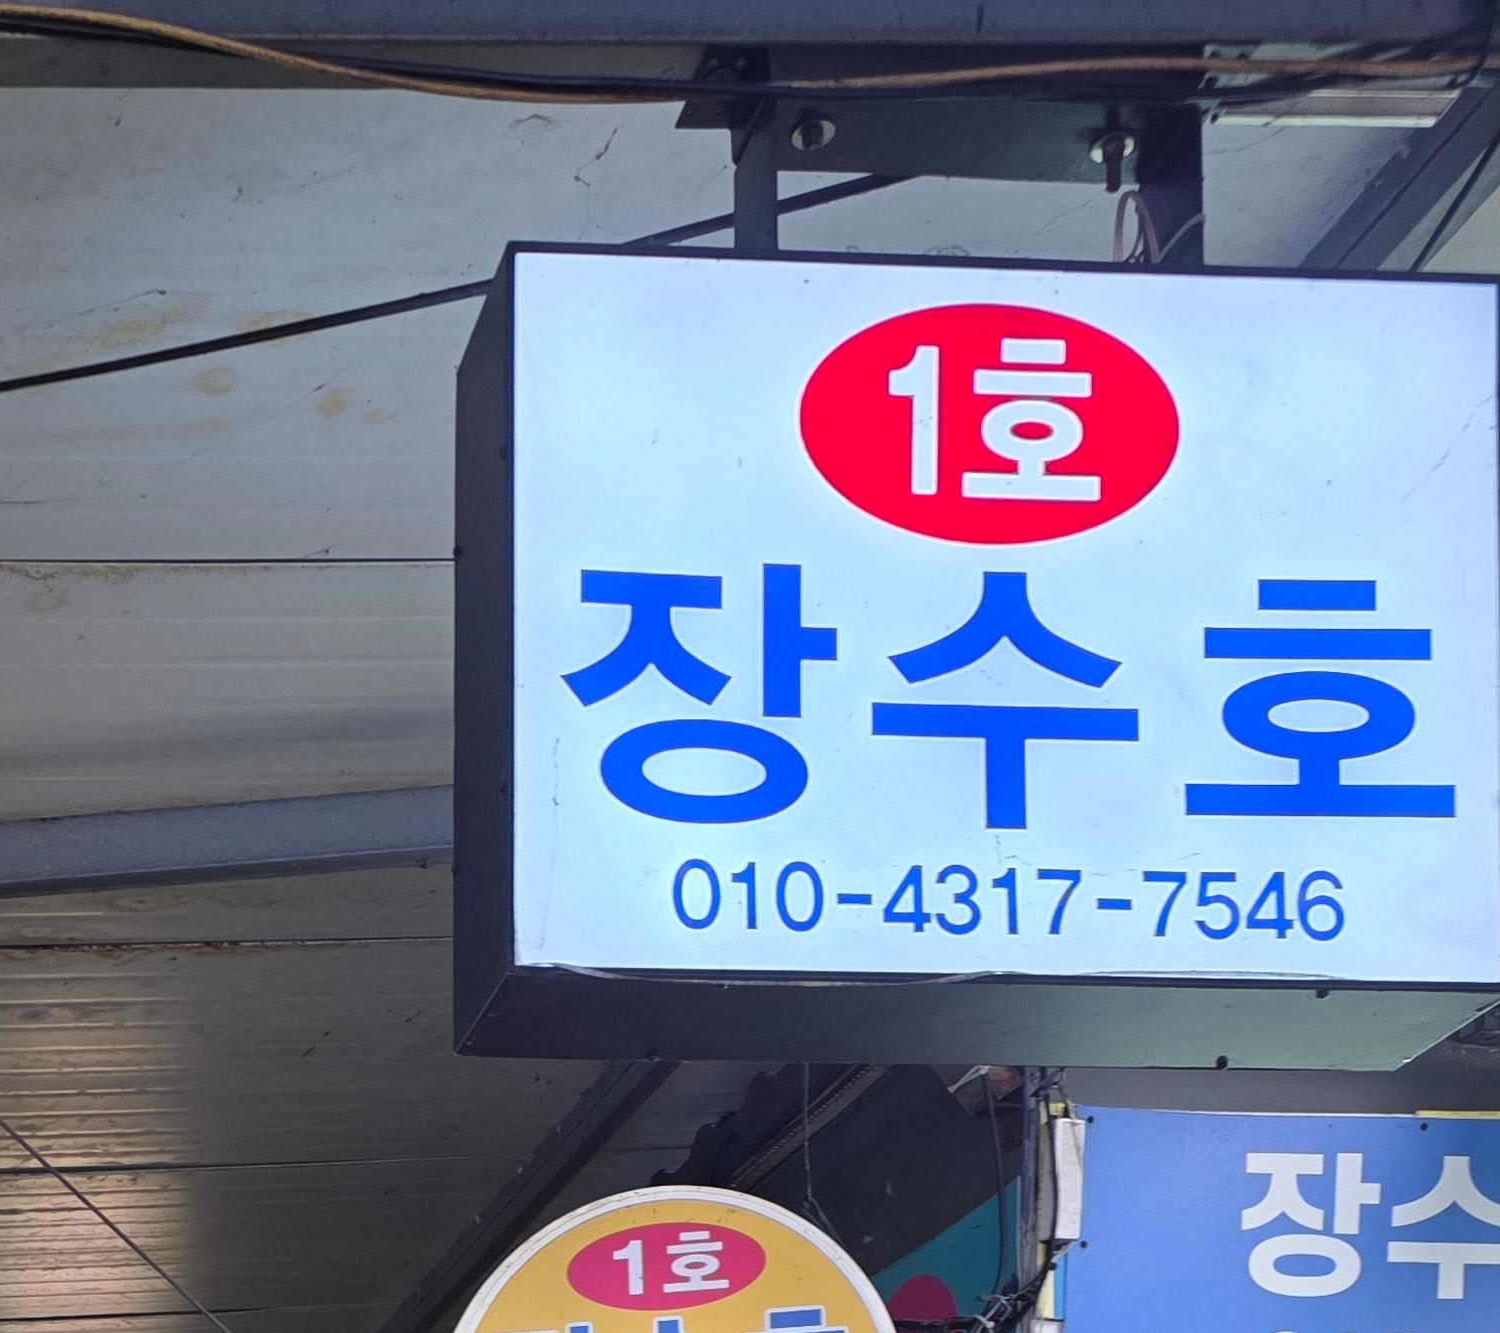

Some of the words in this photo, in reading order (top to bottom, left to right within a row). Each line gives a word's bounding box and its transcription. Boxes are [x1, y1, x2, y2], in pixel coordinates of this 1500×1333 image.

[888, 337, 1100, 501] 1호
[560, 563, 1455, 829] 장수호
[672, 860, 1346, 941] 010-4317-7546
[612, 1231, 730, 1296] 1호
